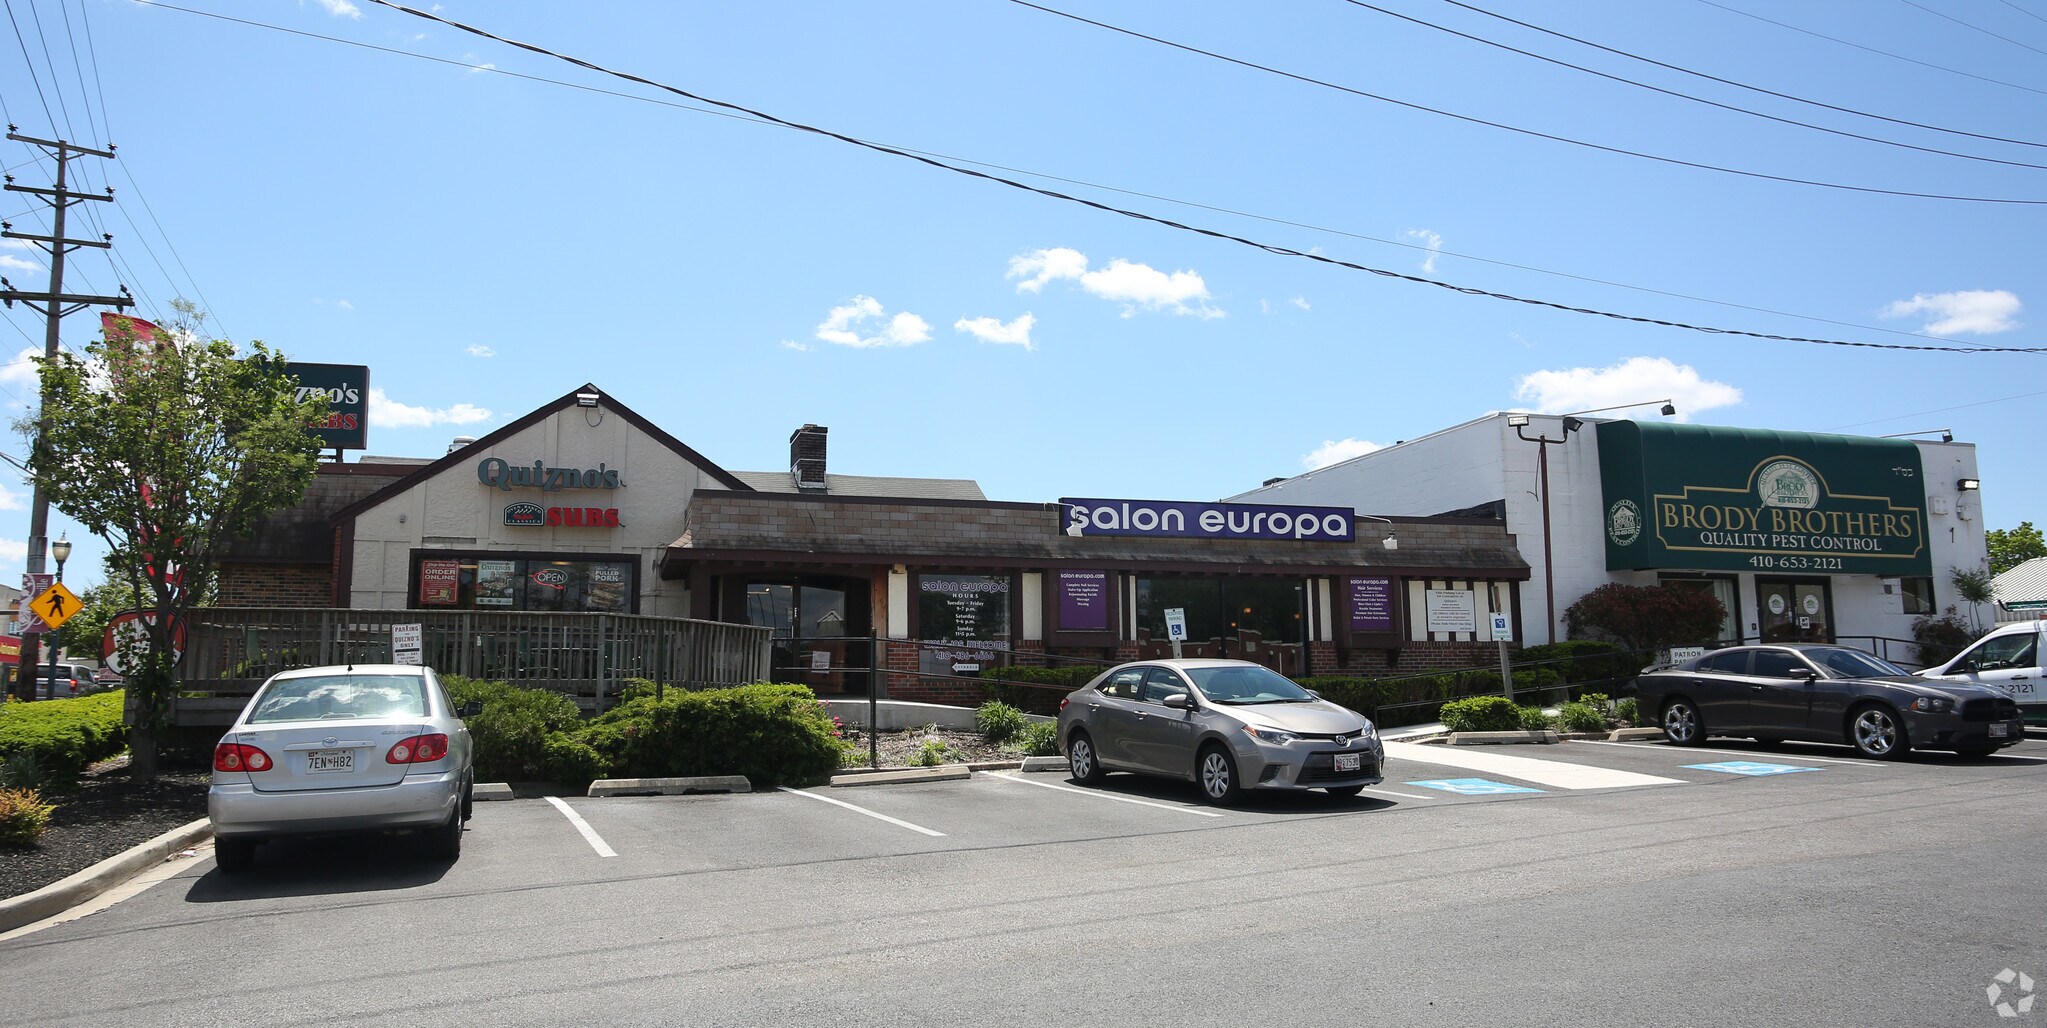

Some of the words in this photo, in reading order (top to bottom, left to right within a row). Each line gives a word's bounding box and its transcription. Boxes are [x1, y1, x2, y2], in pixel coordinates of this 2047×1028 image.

[477, 457, 619, 492] Quizno's
[1776, 478, 1806, 492] BRODY
[546, 506, 620, 528] SUBS
[1070, 502, 1185, 531] salon
[1199, 510, 1347, 539] europa
[1663, 503, 1763, 532] BRODY
[1771, 508, 1912, 538] BROTHERS
[1700, 531, 1768, 547] QUALITY
[1772, 534, 1806, 549] PEST
[1810, 536, 1882, 551] CONTROL
[1749, 556, 1843, 569] 410-653-2121
[537, 572, 564, 582] OPEN
[921, 581, 958, 592] salon
[960, 582, 1008, 594] europa
[394, 635, 420, 643] QUIZNO'S
[966, 640, 1008, 649] WELCOME
